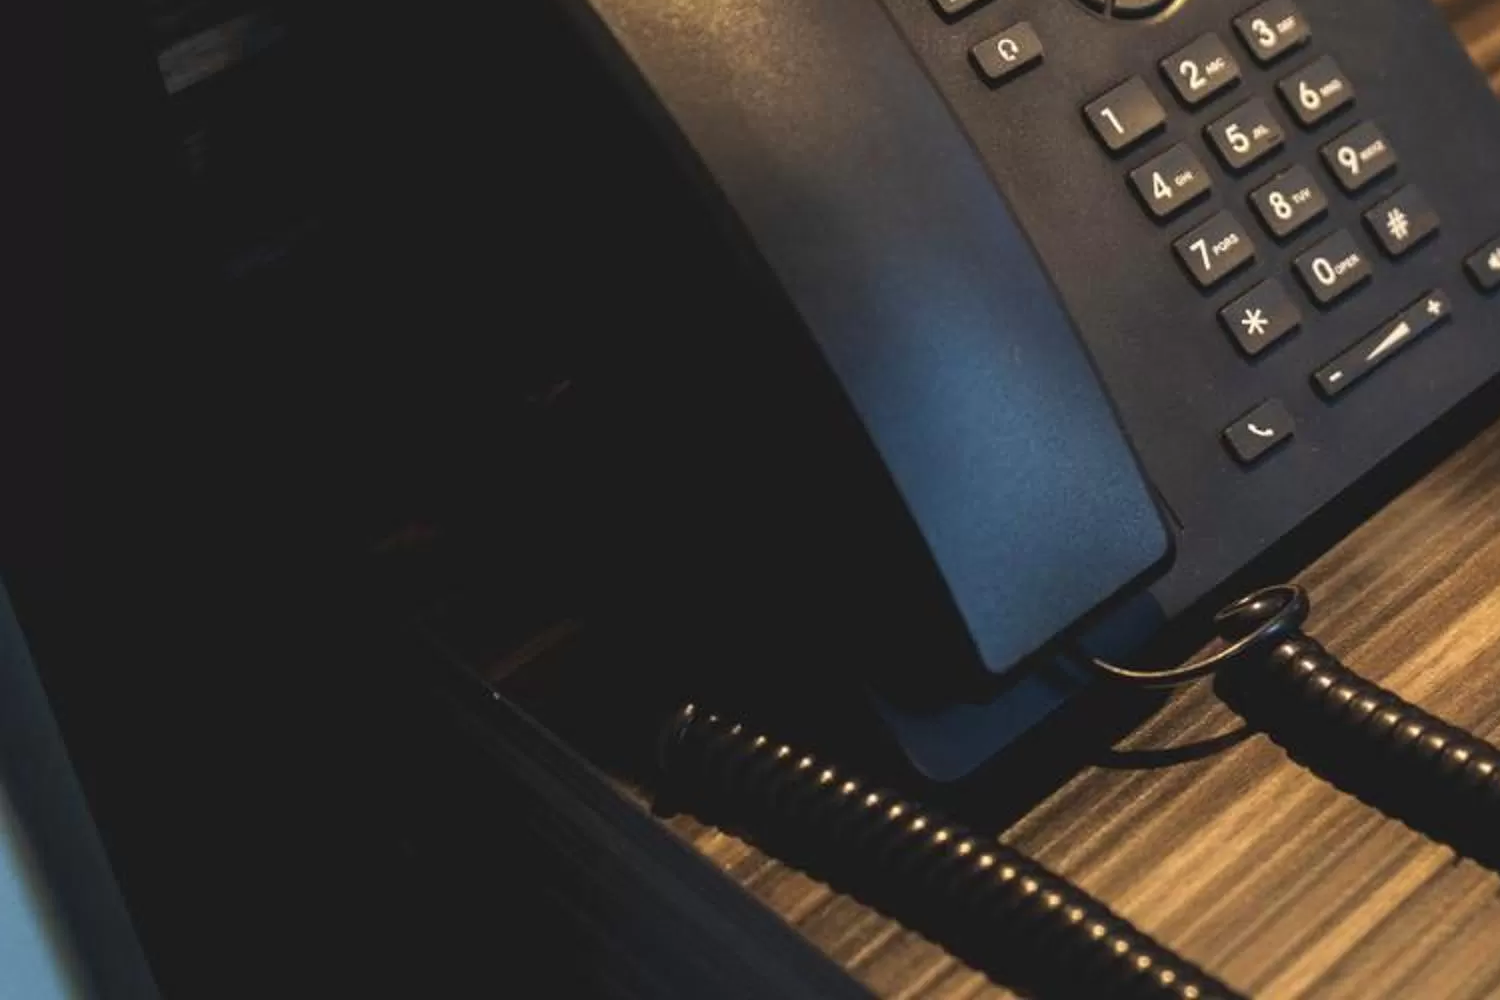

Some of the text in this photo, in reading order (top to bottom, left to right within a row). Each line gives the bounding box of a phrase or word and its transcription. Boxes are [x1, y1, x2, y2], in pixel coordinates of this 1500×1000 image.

[1251, 18, 1278, 47] 3
[1178, 60, 1208, 90] 2
[1299, 80, 1321, 110] 6
[1101, 107, 1124, 135] 1
[1224, 123, 1250, 153] 5
[1337, 146, 1360, 175] 9
[1151, 171, 1173, 199] 4
[1268, 191, 1292, 220] 8
[1188, 238, 1211, 271] 7
[1311, 257, 1336, 286] 0
